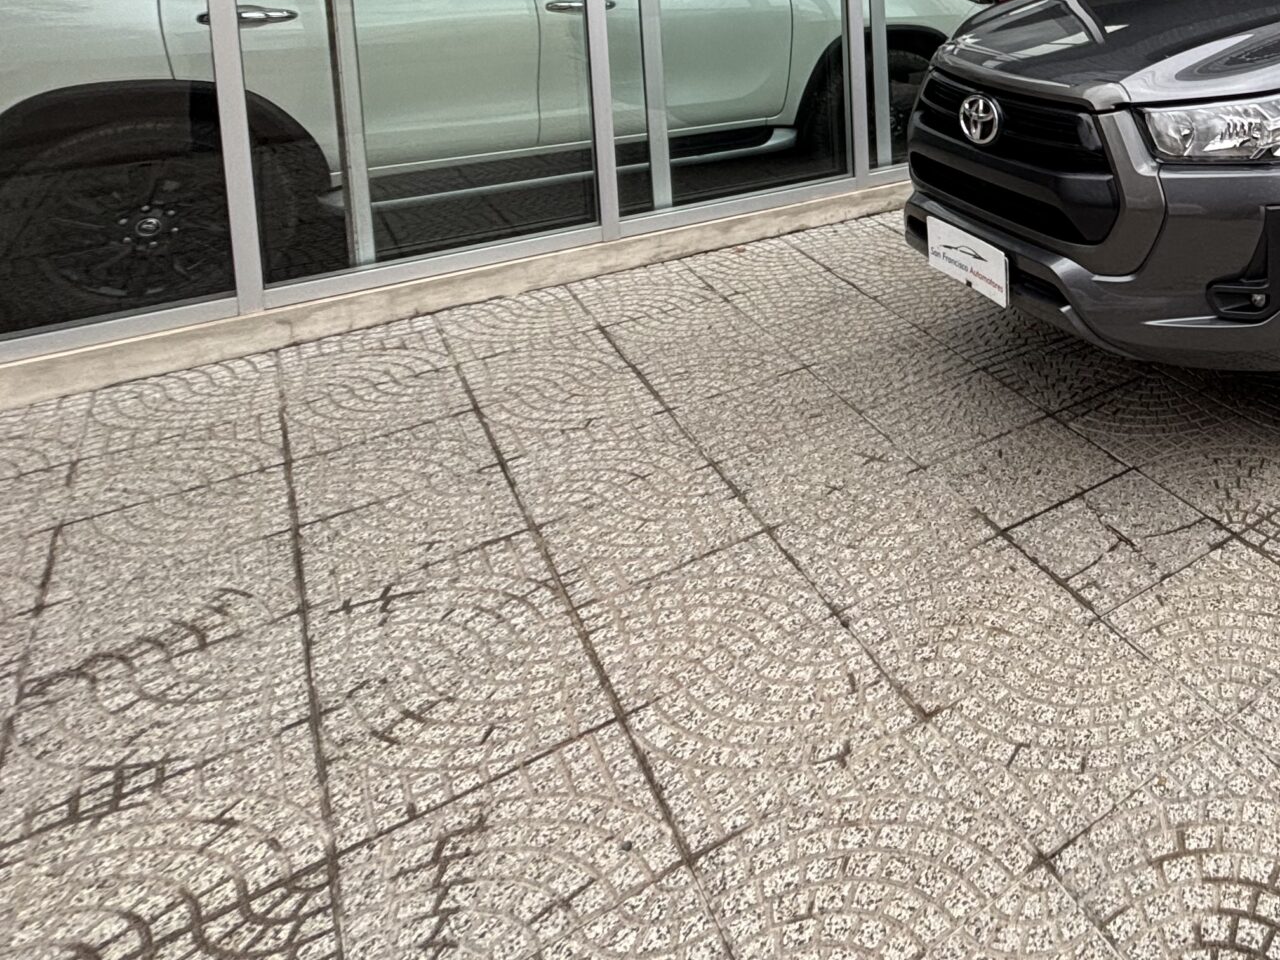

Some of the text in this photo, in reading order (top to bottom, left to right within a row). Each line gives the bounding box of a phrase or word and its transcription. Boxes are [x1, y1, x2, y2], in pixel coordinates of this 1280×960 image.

[930, 247, 1003, 293] San Francisco Automotores
